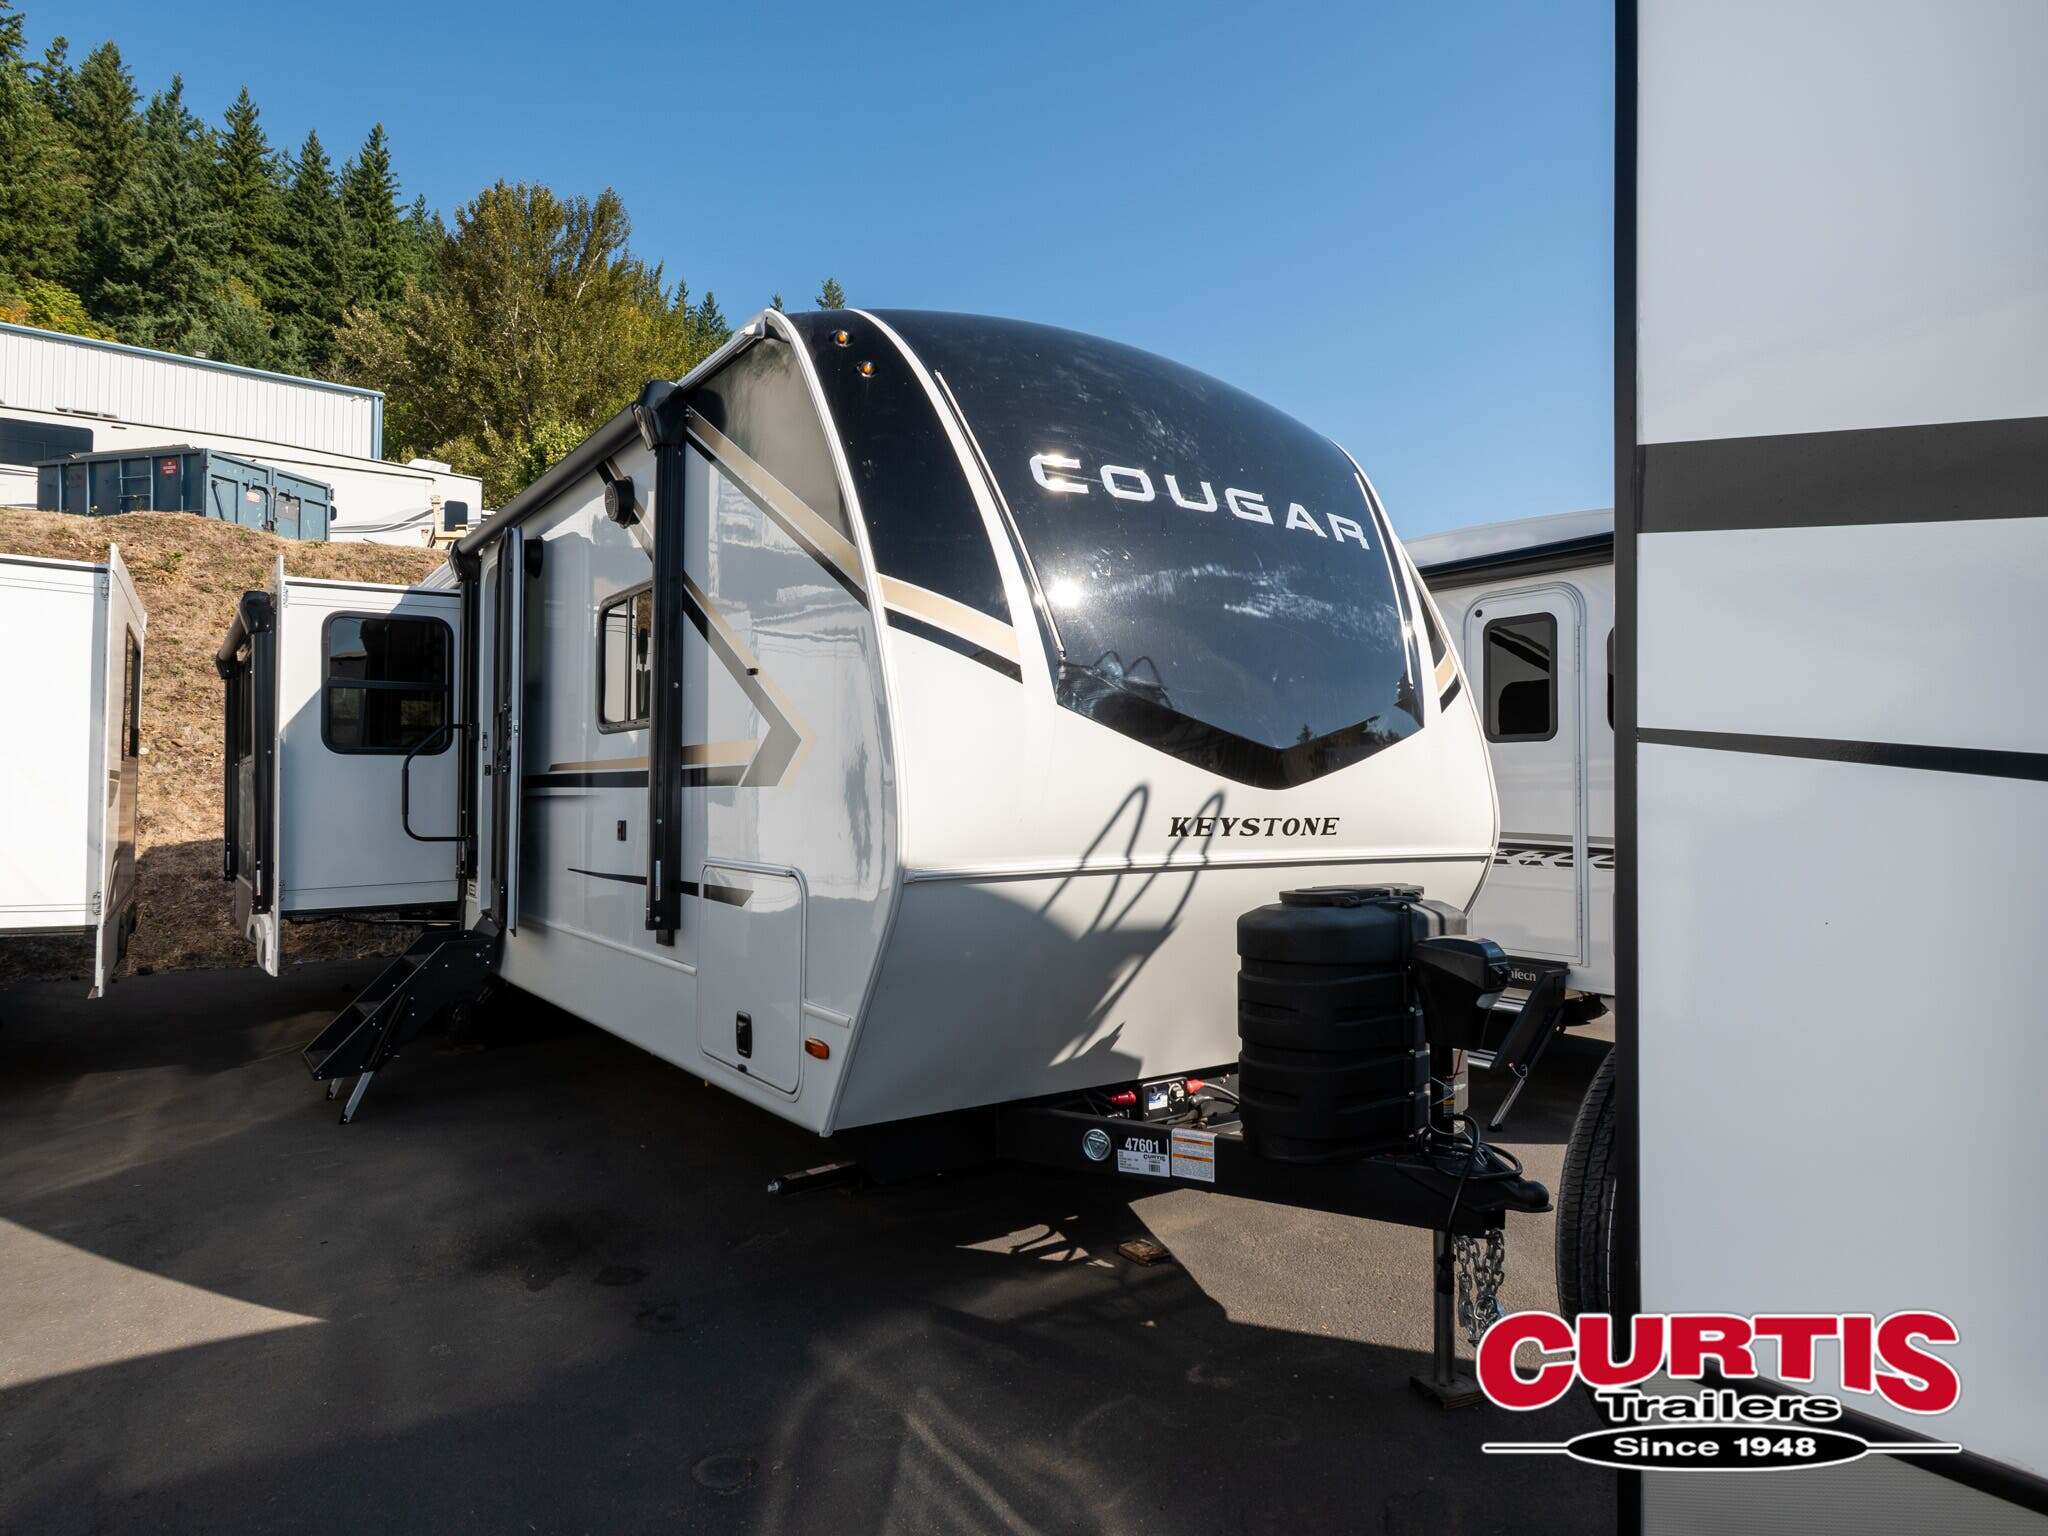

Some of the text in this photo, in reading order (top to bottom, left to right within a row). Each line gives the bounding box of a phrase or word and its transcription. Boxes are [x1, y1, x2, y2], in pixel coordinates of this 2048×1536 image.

[1029, 453, 1370, 550] COUGAR
[1168, 816, 1340, 837] KEYSTONE
[1125, 1137, 1160, 1154] 47601
